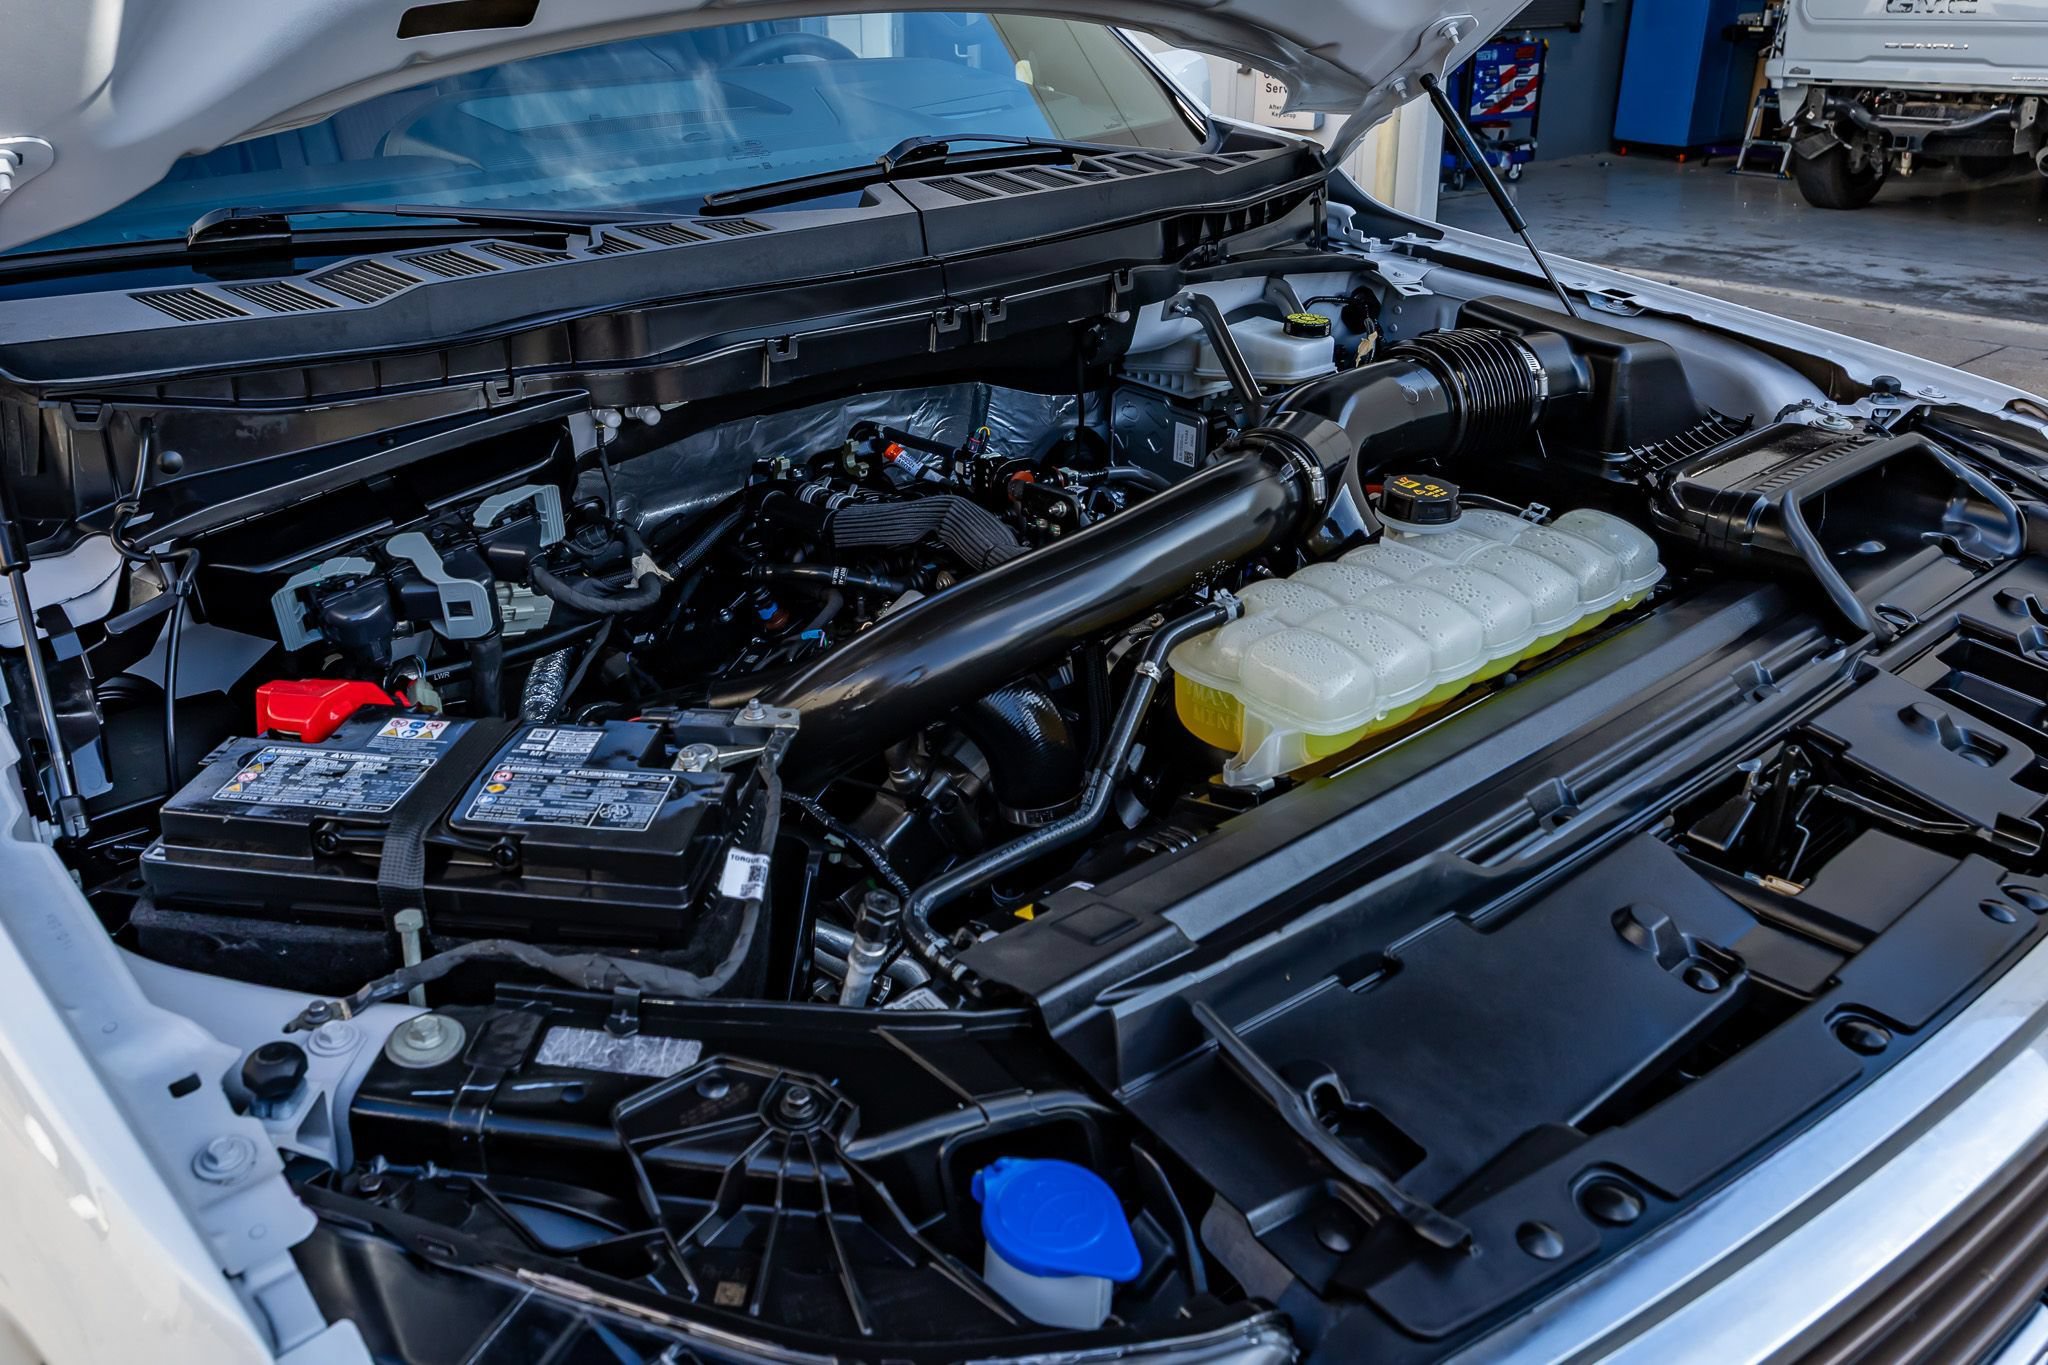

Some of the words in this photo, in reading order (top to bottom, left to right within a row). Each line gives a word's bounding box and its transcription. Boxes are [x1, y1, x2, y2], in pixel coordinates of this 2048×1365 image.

[1885, 42, 1969, 50] DENALI
[433, 671, 450, 681] LWR
[731, 854, 760, 864] TORQUE
